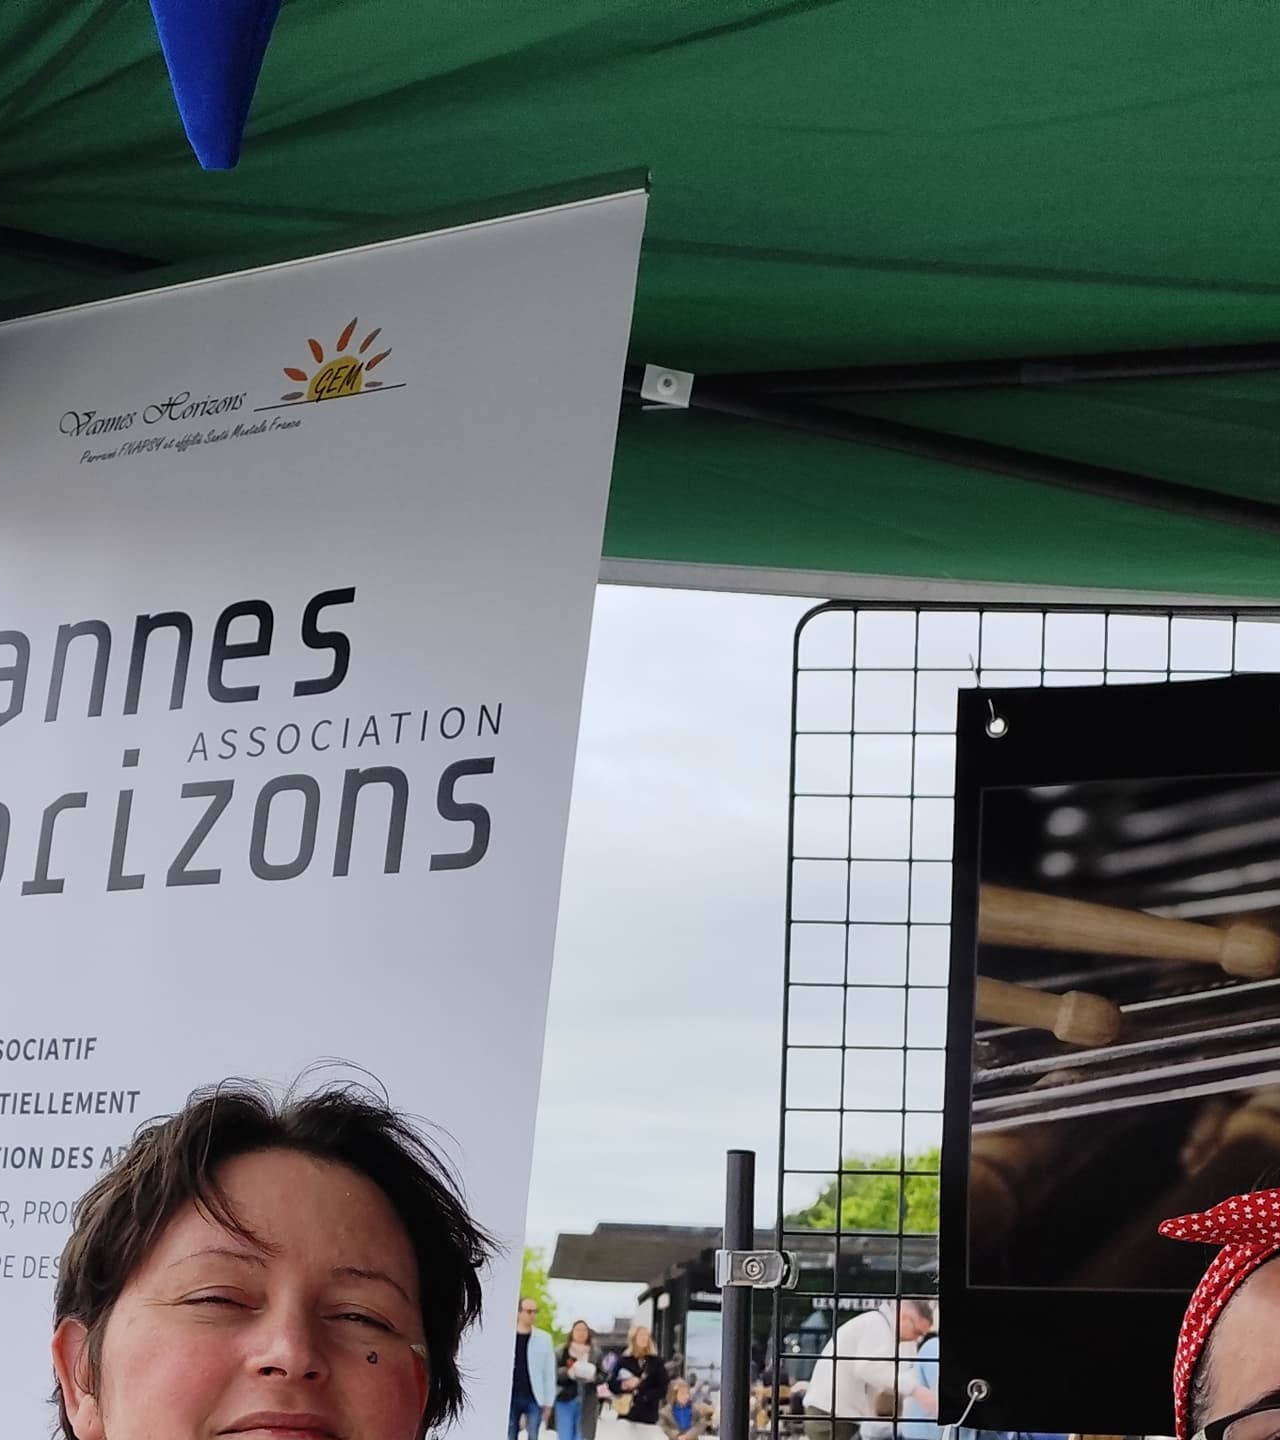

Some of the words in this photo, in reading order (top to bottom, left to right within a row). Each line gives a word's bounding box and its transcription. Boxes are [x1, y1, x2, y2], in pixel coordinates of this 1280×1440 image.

[314, 362, 365, 402] GEM
[59, 411, 137, 437] Vannes
[143, 391, 247, 425] Horizons
[186, 702, 503, 764] ASSOCIATION
[51, 1146, 94, 1170] DES
